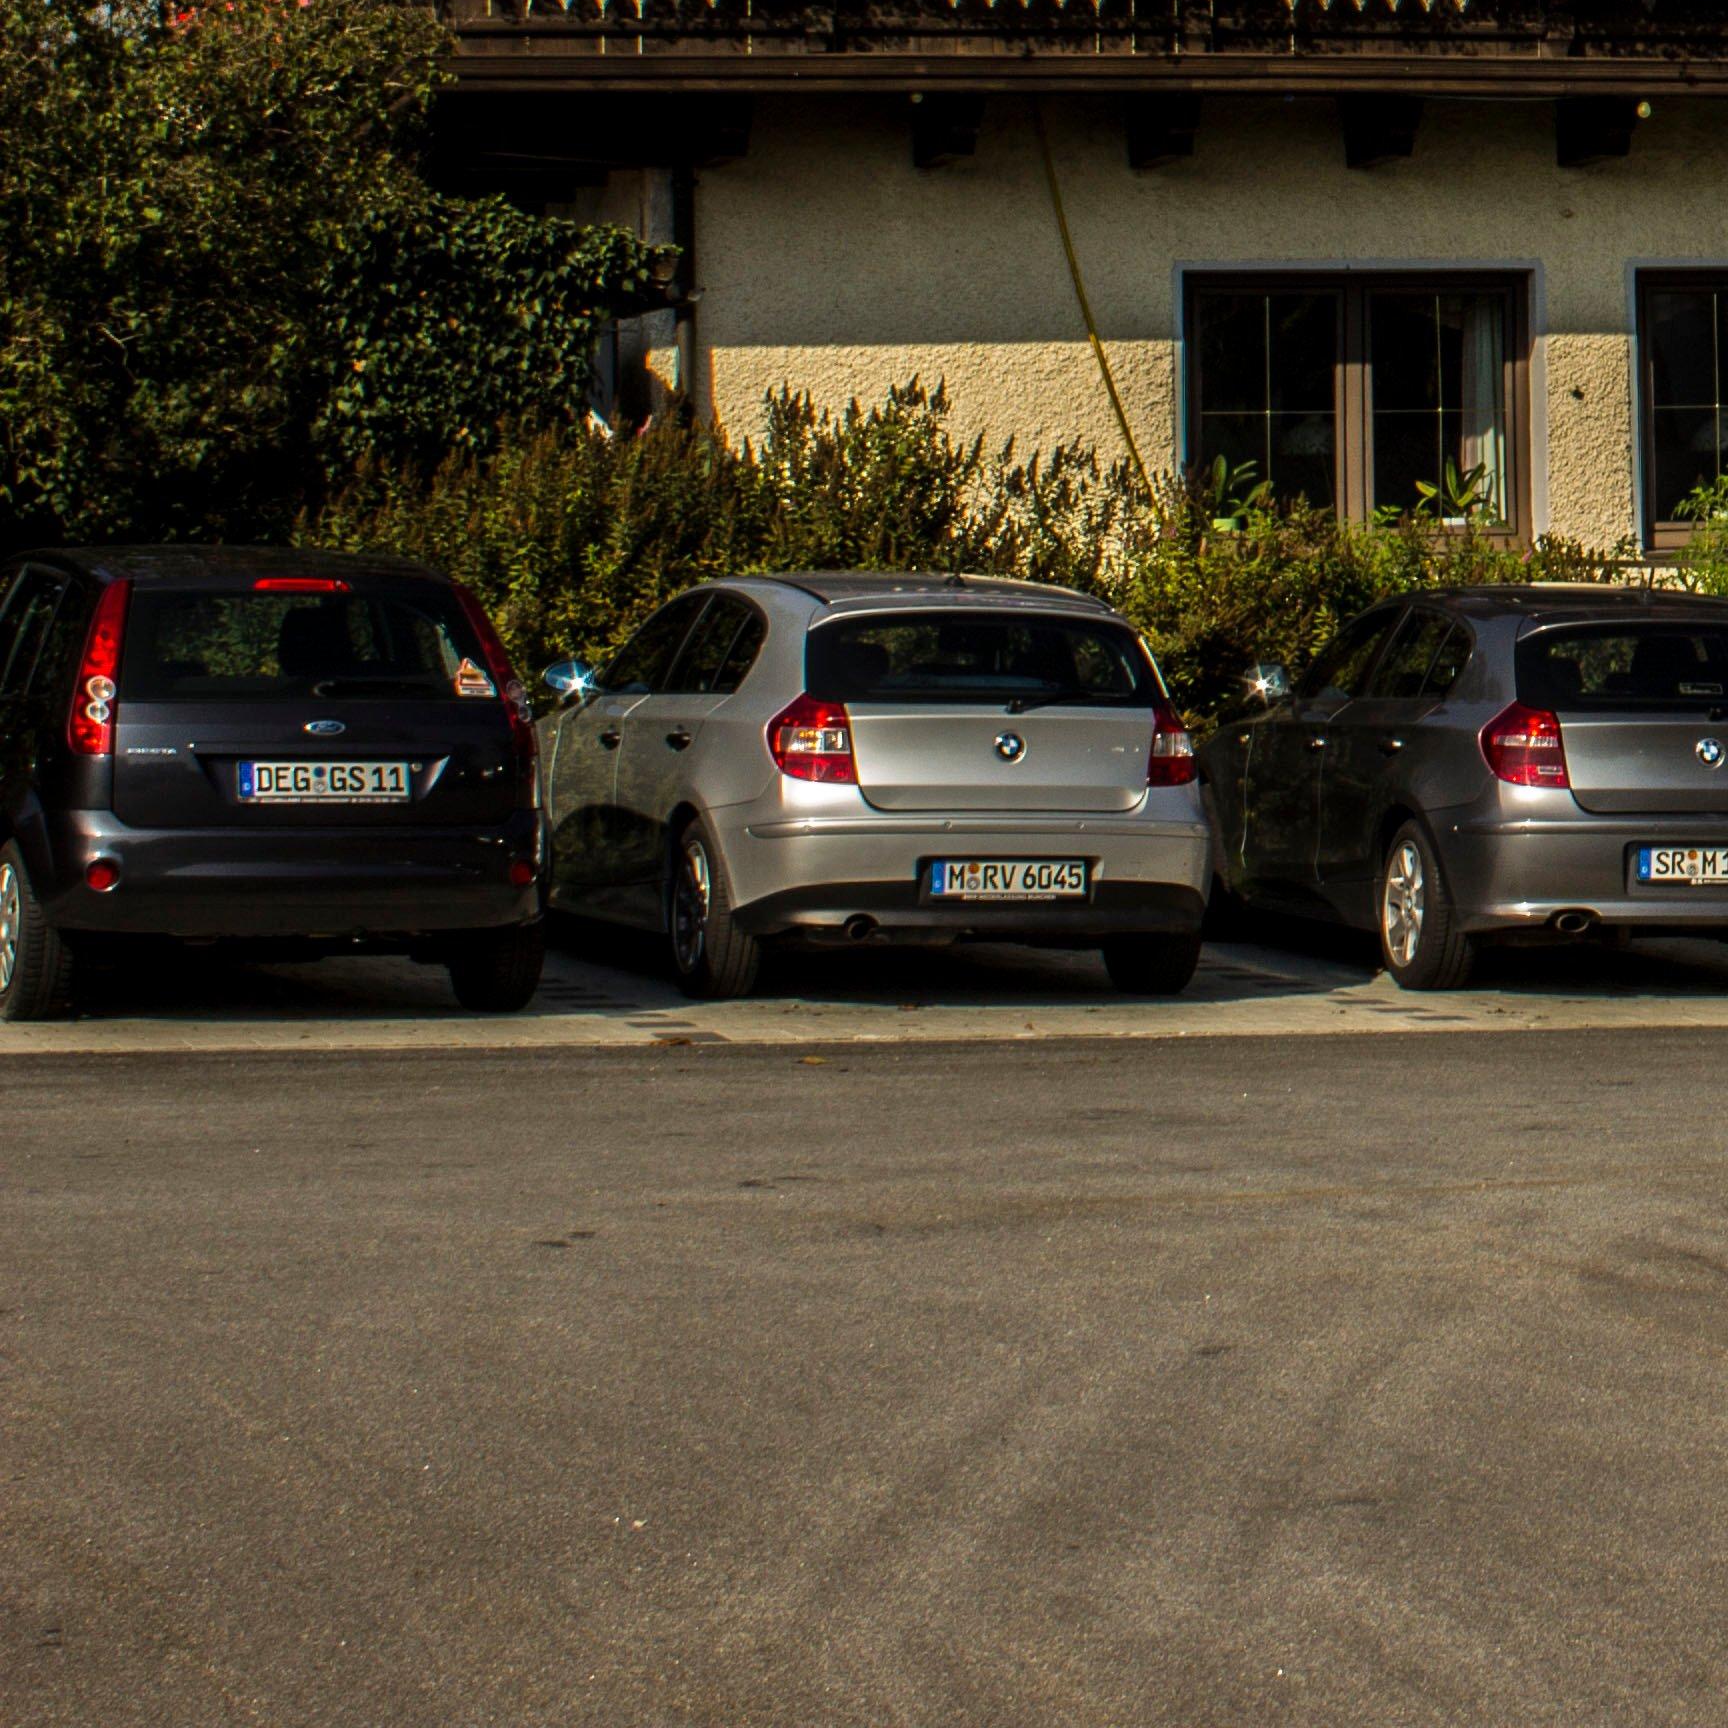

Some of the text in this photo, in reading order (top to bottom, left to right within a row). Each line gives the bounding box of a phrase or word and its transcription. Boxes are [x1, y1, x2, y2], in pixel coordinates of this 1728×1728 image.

[256, 765, 405, 792] DEG GS 11
[1655, 851, 1685, 875] SR
[1702, 851, 1717, 875] M
[949, 864, 1083, 890] M RV 6045
